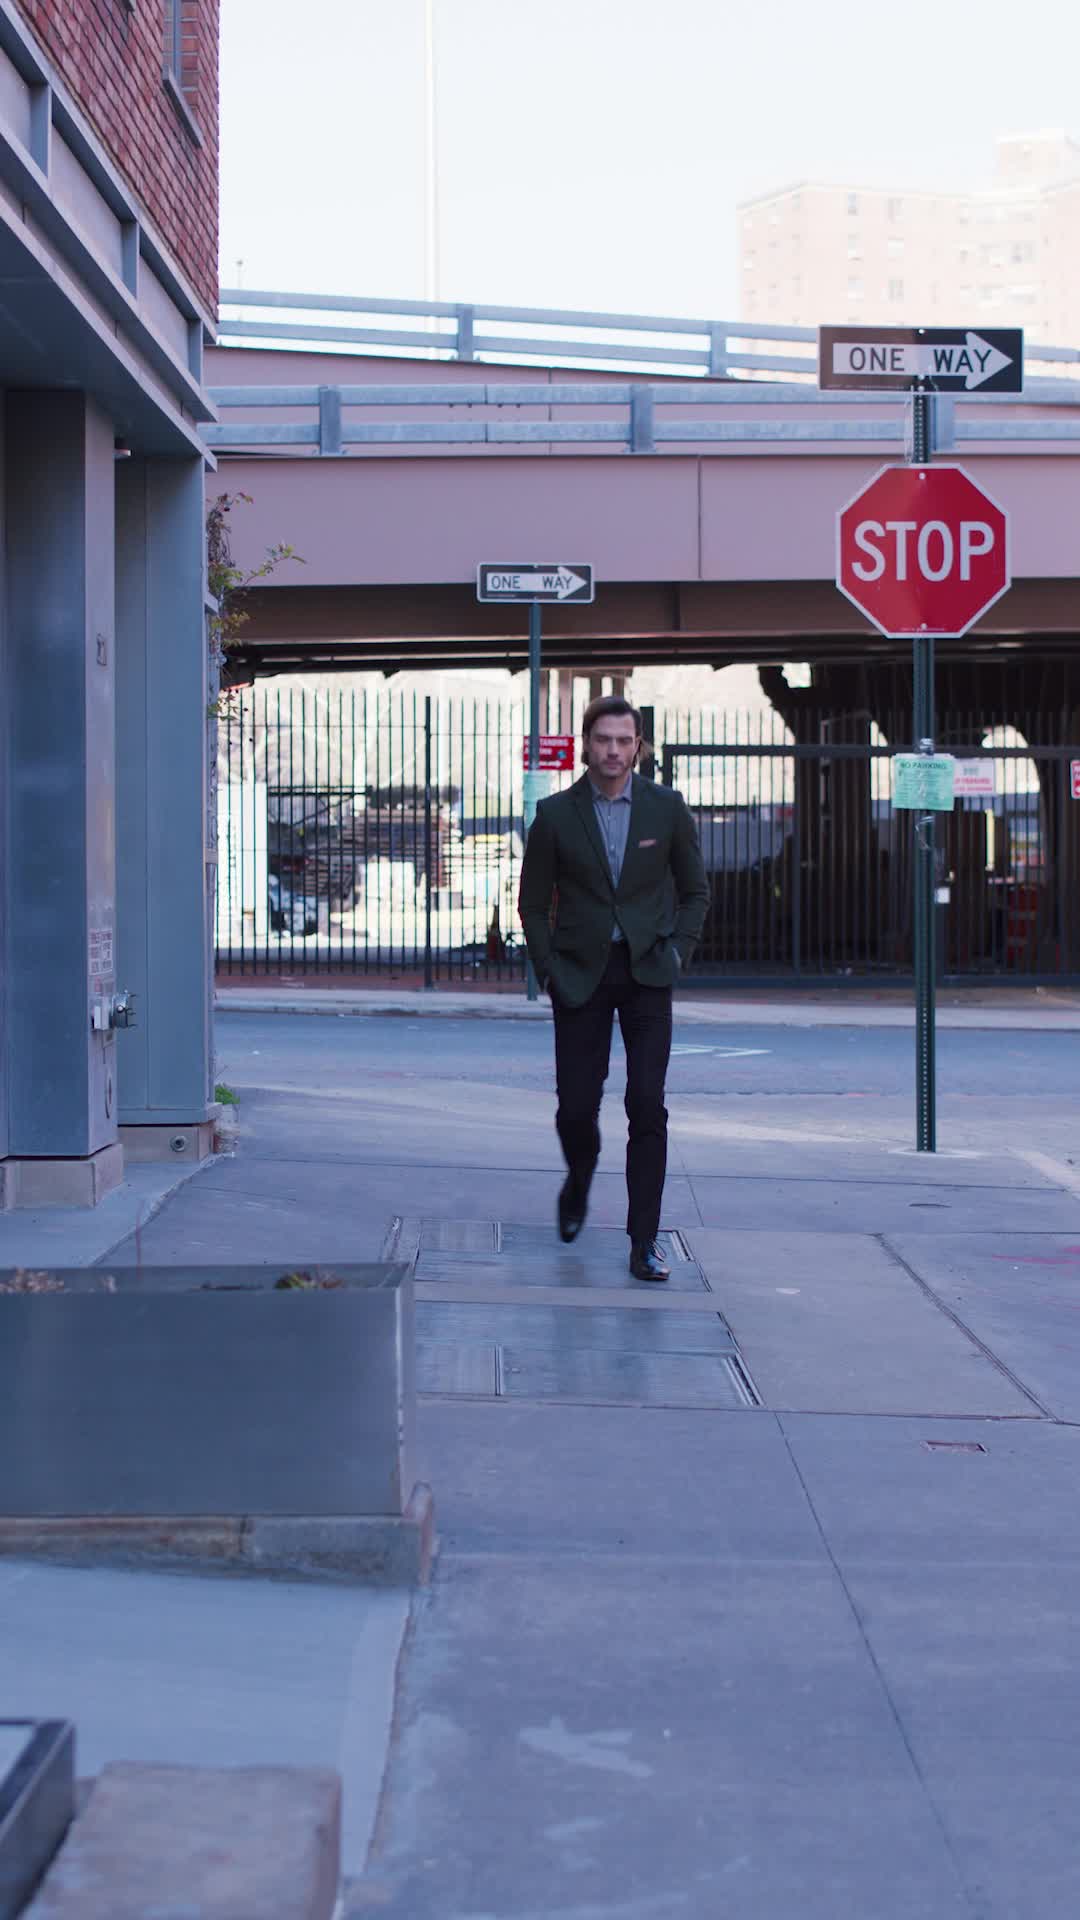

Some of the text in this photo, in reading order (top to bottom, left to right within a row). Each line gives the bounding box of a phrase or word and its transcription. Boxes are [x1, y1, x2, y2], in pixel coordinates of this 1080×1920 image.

[849, 347, 993, 373] ONE WAY
[851, 520, 995, 581] STOP
[491, 575, 574, 589] ONE WAY
[900, 761, 911, 769] NO
